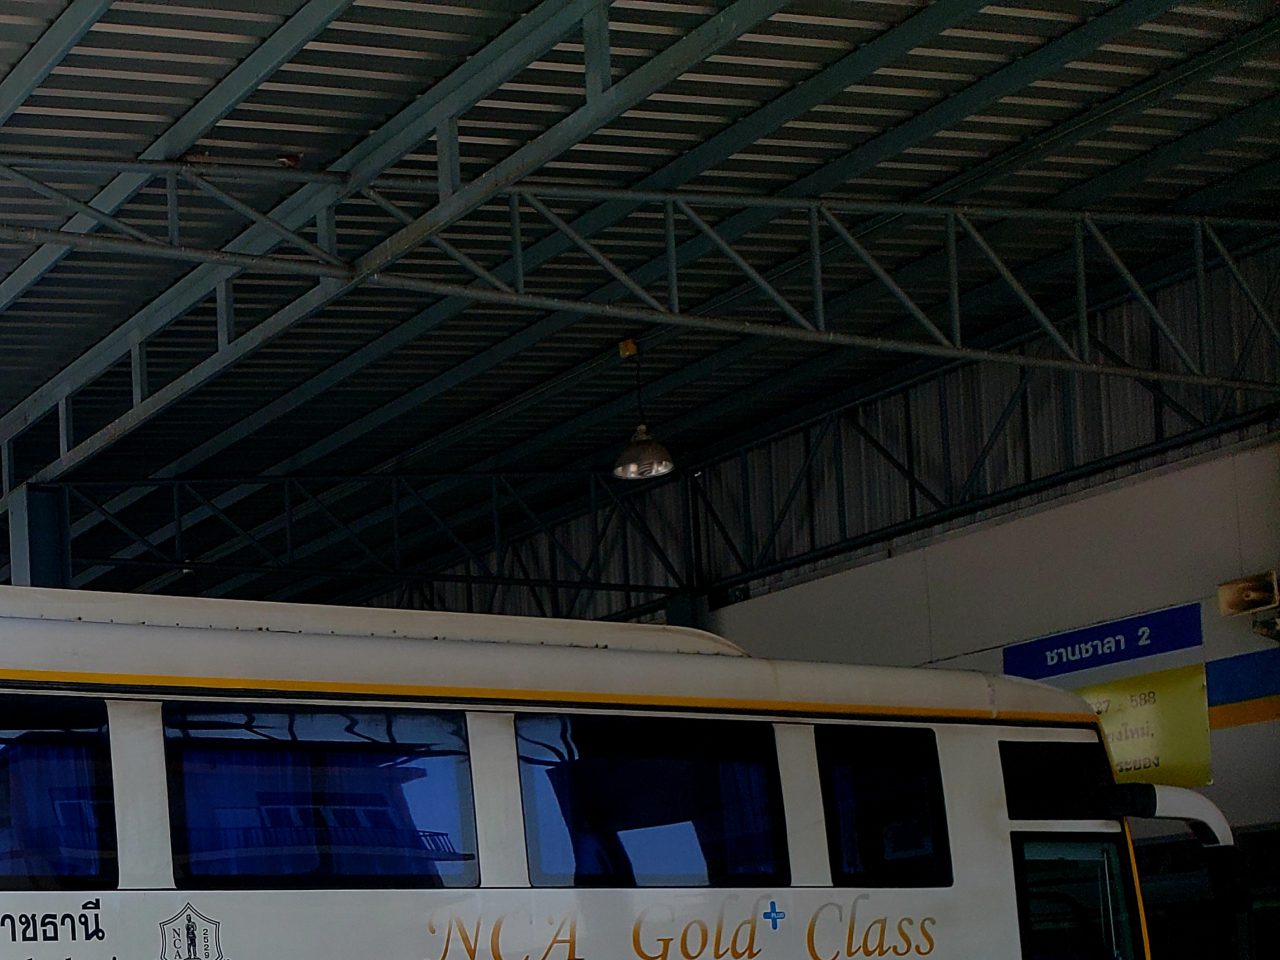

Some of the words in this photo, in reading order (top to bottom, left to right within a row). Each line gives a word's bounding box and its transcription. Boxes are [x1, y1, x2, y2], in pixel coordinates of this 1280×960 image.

[1045, 634, 1125, 666] ชานชาลา
[1138, 626, 1151, 646] 2
[171, 927, 182, 960] NCA
